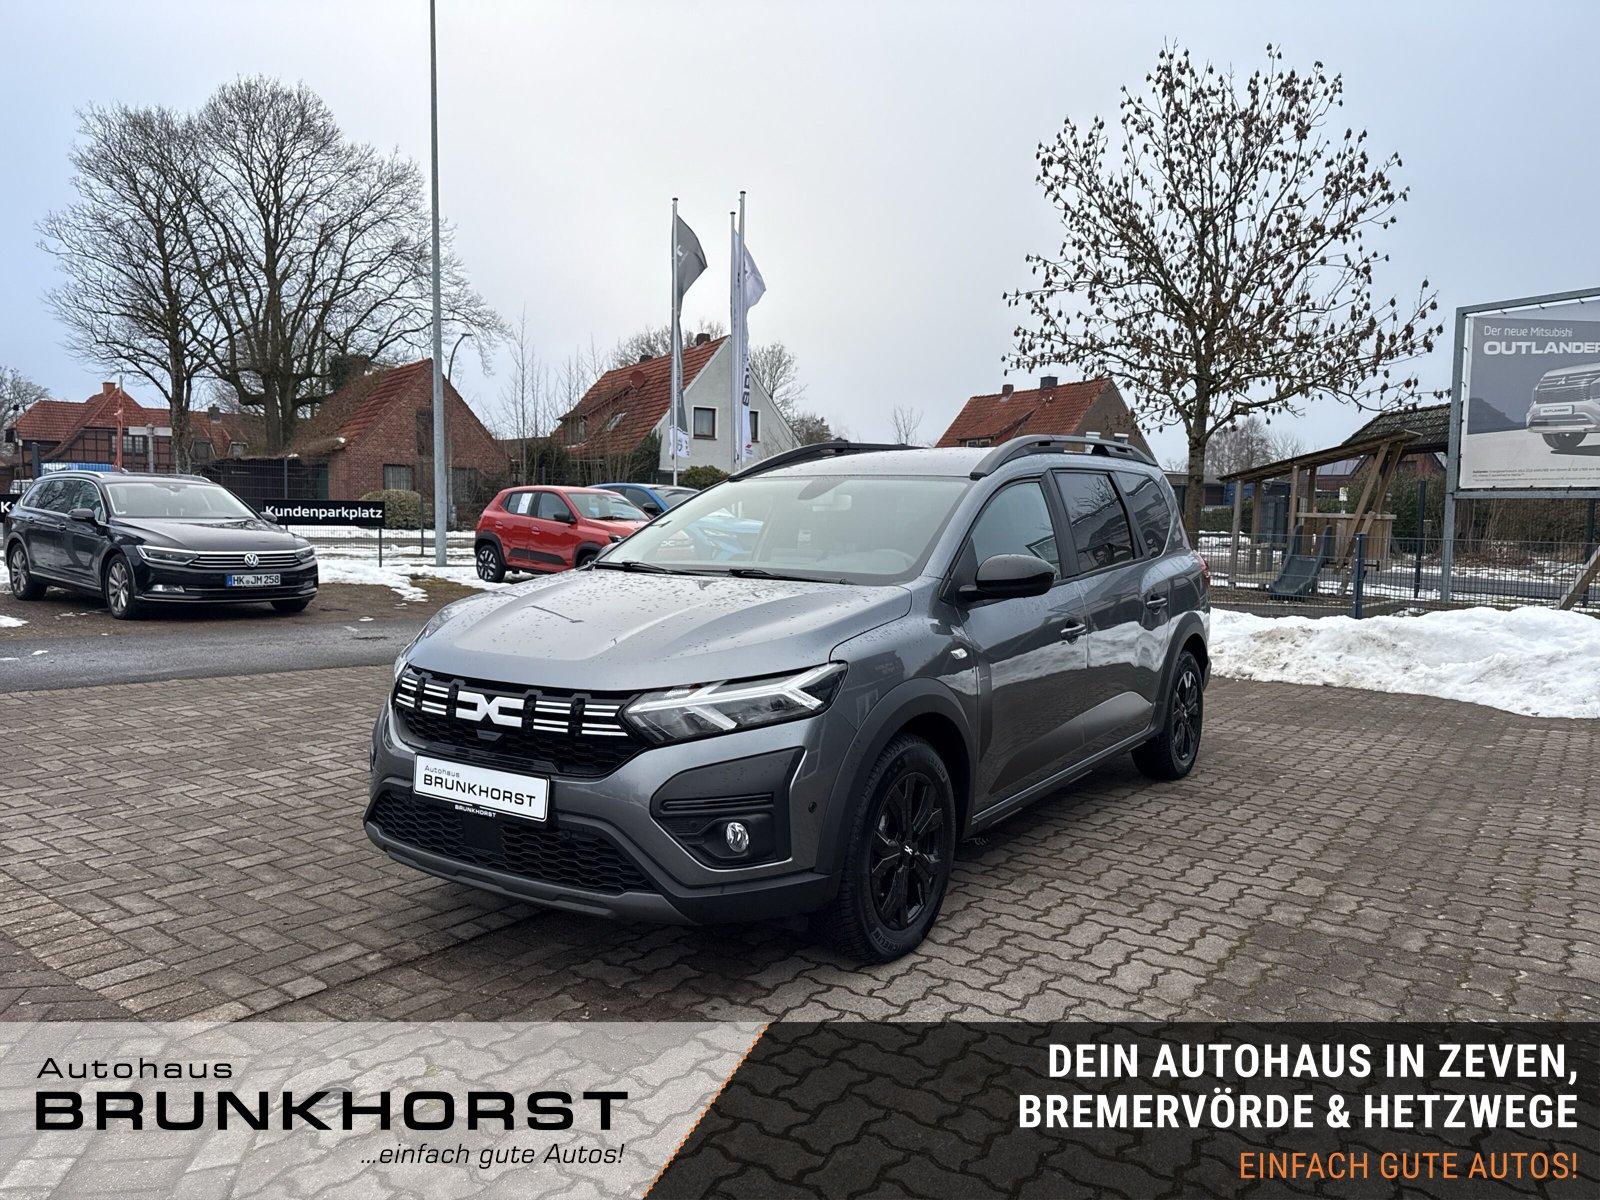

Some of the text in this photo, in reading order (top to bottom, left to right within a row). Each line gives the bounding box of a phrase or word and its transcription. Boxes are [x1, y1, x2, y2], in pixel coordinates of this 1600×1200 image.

[1484, 325, 1573, 338] Der neue Mitsubishi
[265, 505, 383, 520] Kundenparkplatz
[233, 575, 245, 585] HK
[264, 574, 280, 585] 258
[424, 765, 460, 778] Autohaus
[423, 774, 536, 807] BRUNKHORST
[454, 804, 497, 818] BRUNKHORST
